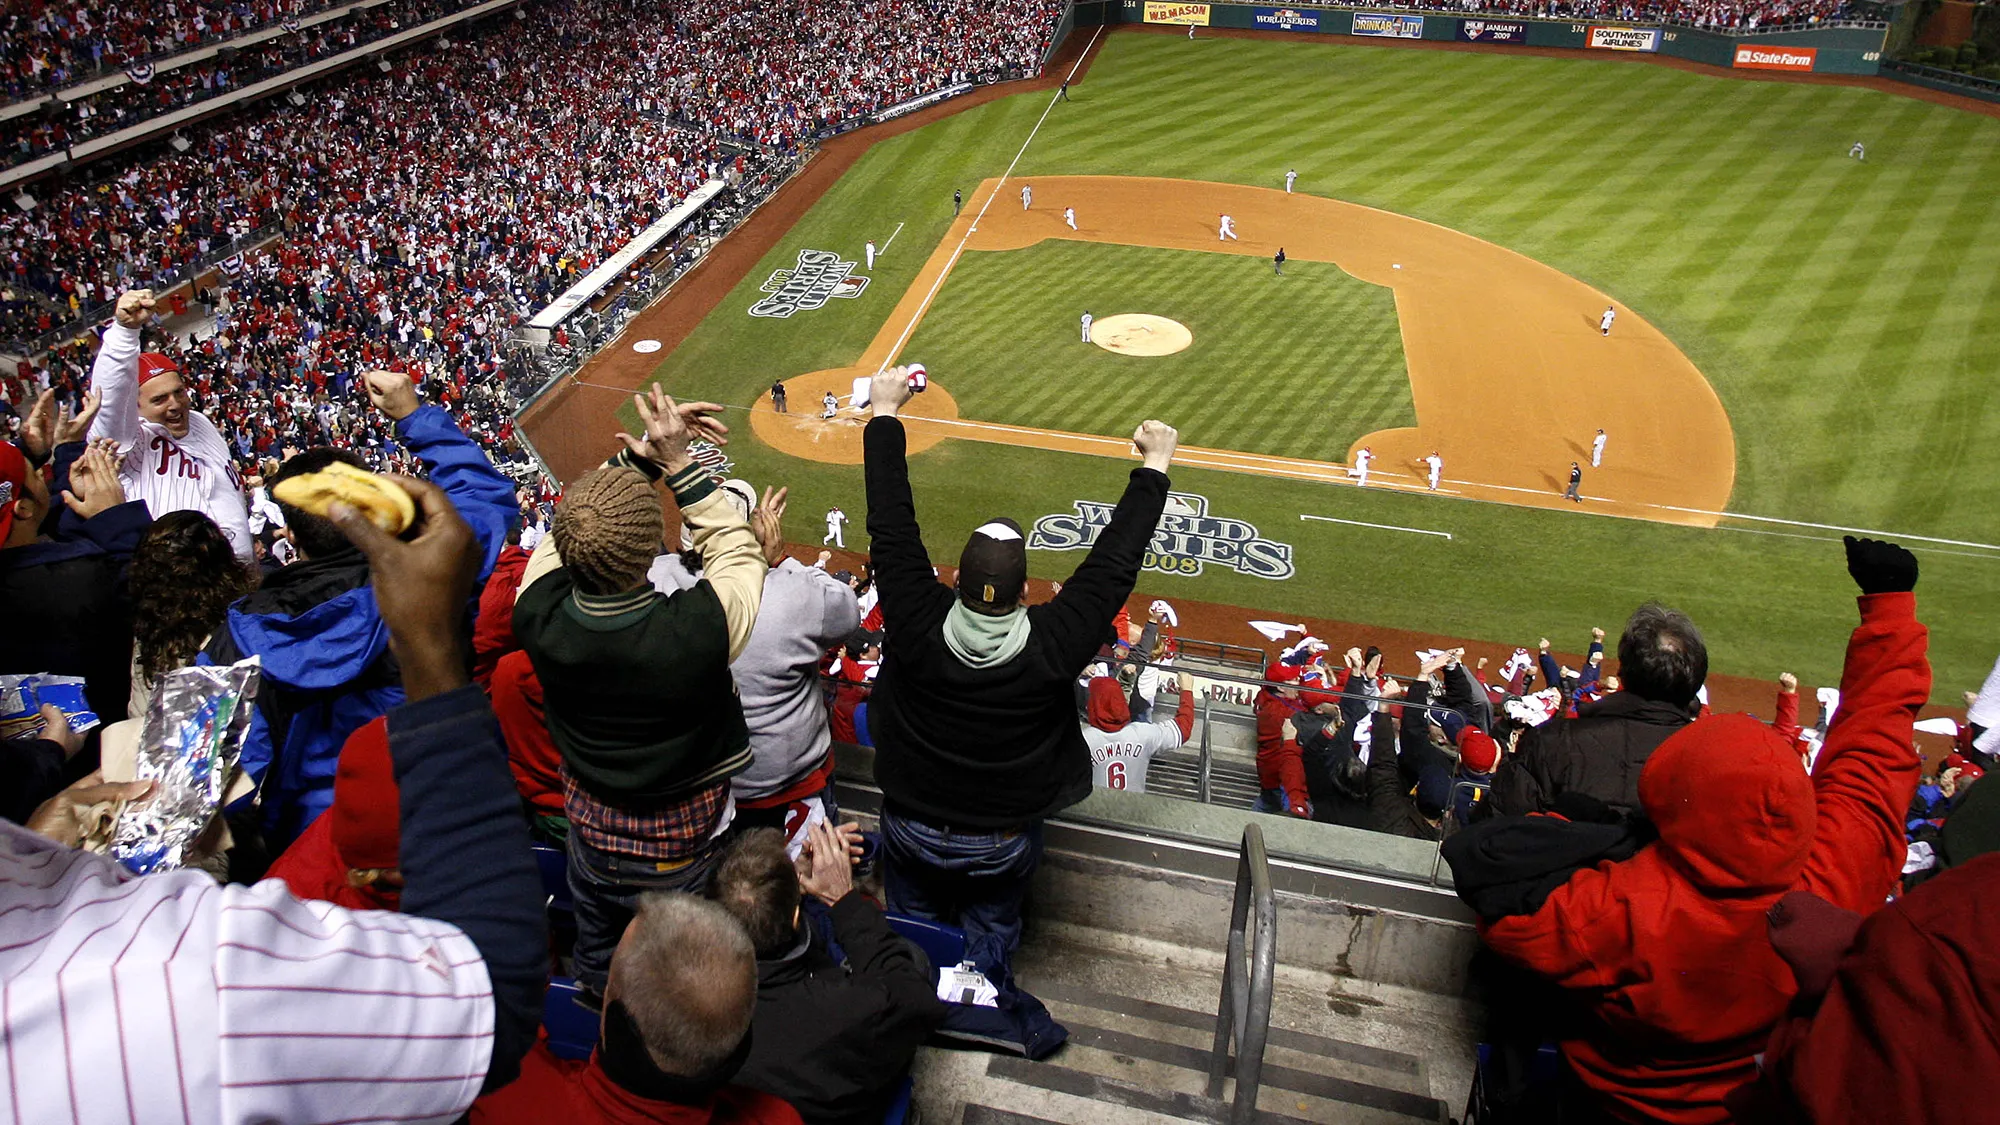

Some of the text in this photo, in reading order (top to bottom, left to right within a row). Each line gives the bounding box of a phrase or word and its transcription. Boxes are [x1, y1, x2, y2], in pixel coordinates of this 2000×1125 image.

[1256, 15, 1317, 26] WORLD SERIES
[1485, 24, 1517, 33] JANUARY
[1493, 32, 1511, 40] 2009
[1595, 30, 1653, 40] SOUTHWEST
[1601, 38, 1643, 48] AIRLINES
[750, 250, 839, 317] SERIES
[797, 262, 856, 310] WORLD
[1080, 503, 1253, 542] WRLD
[1107, 761, 1127, 791] 6
